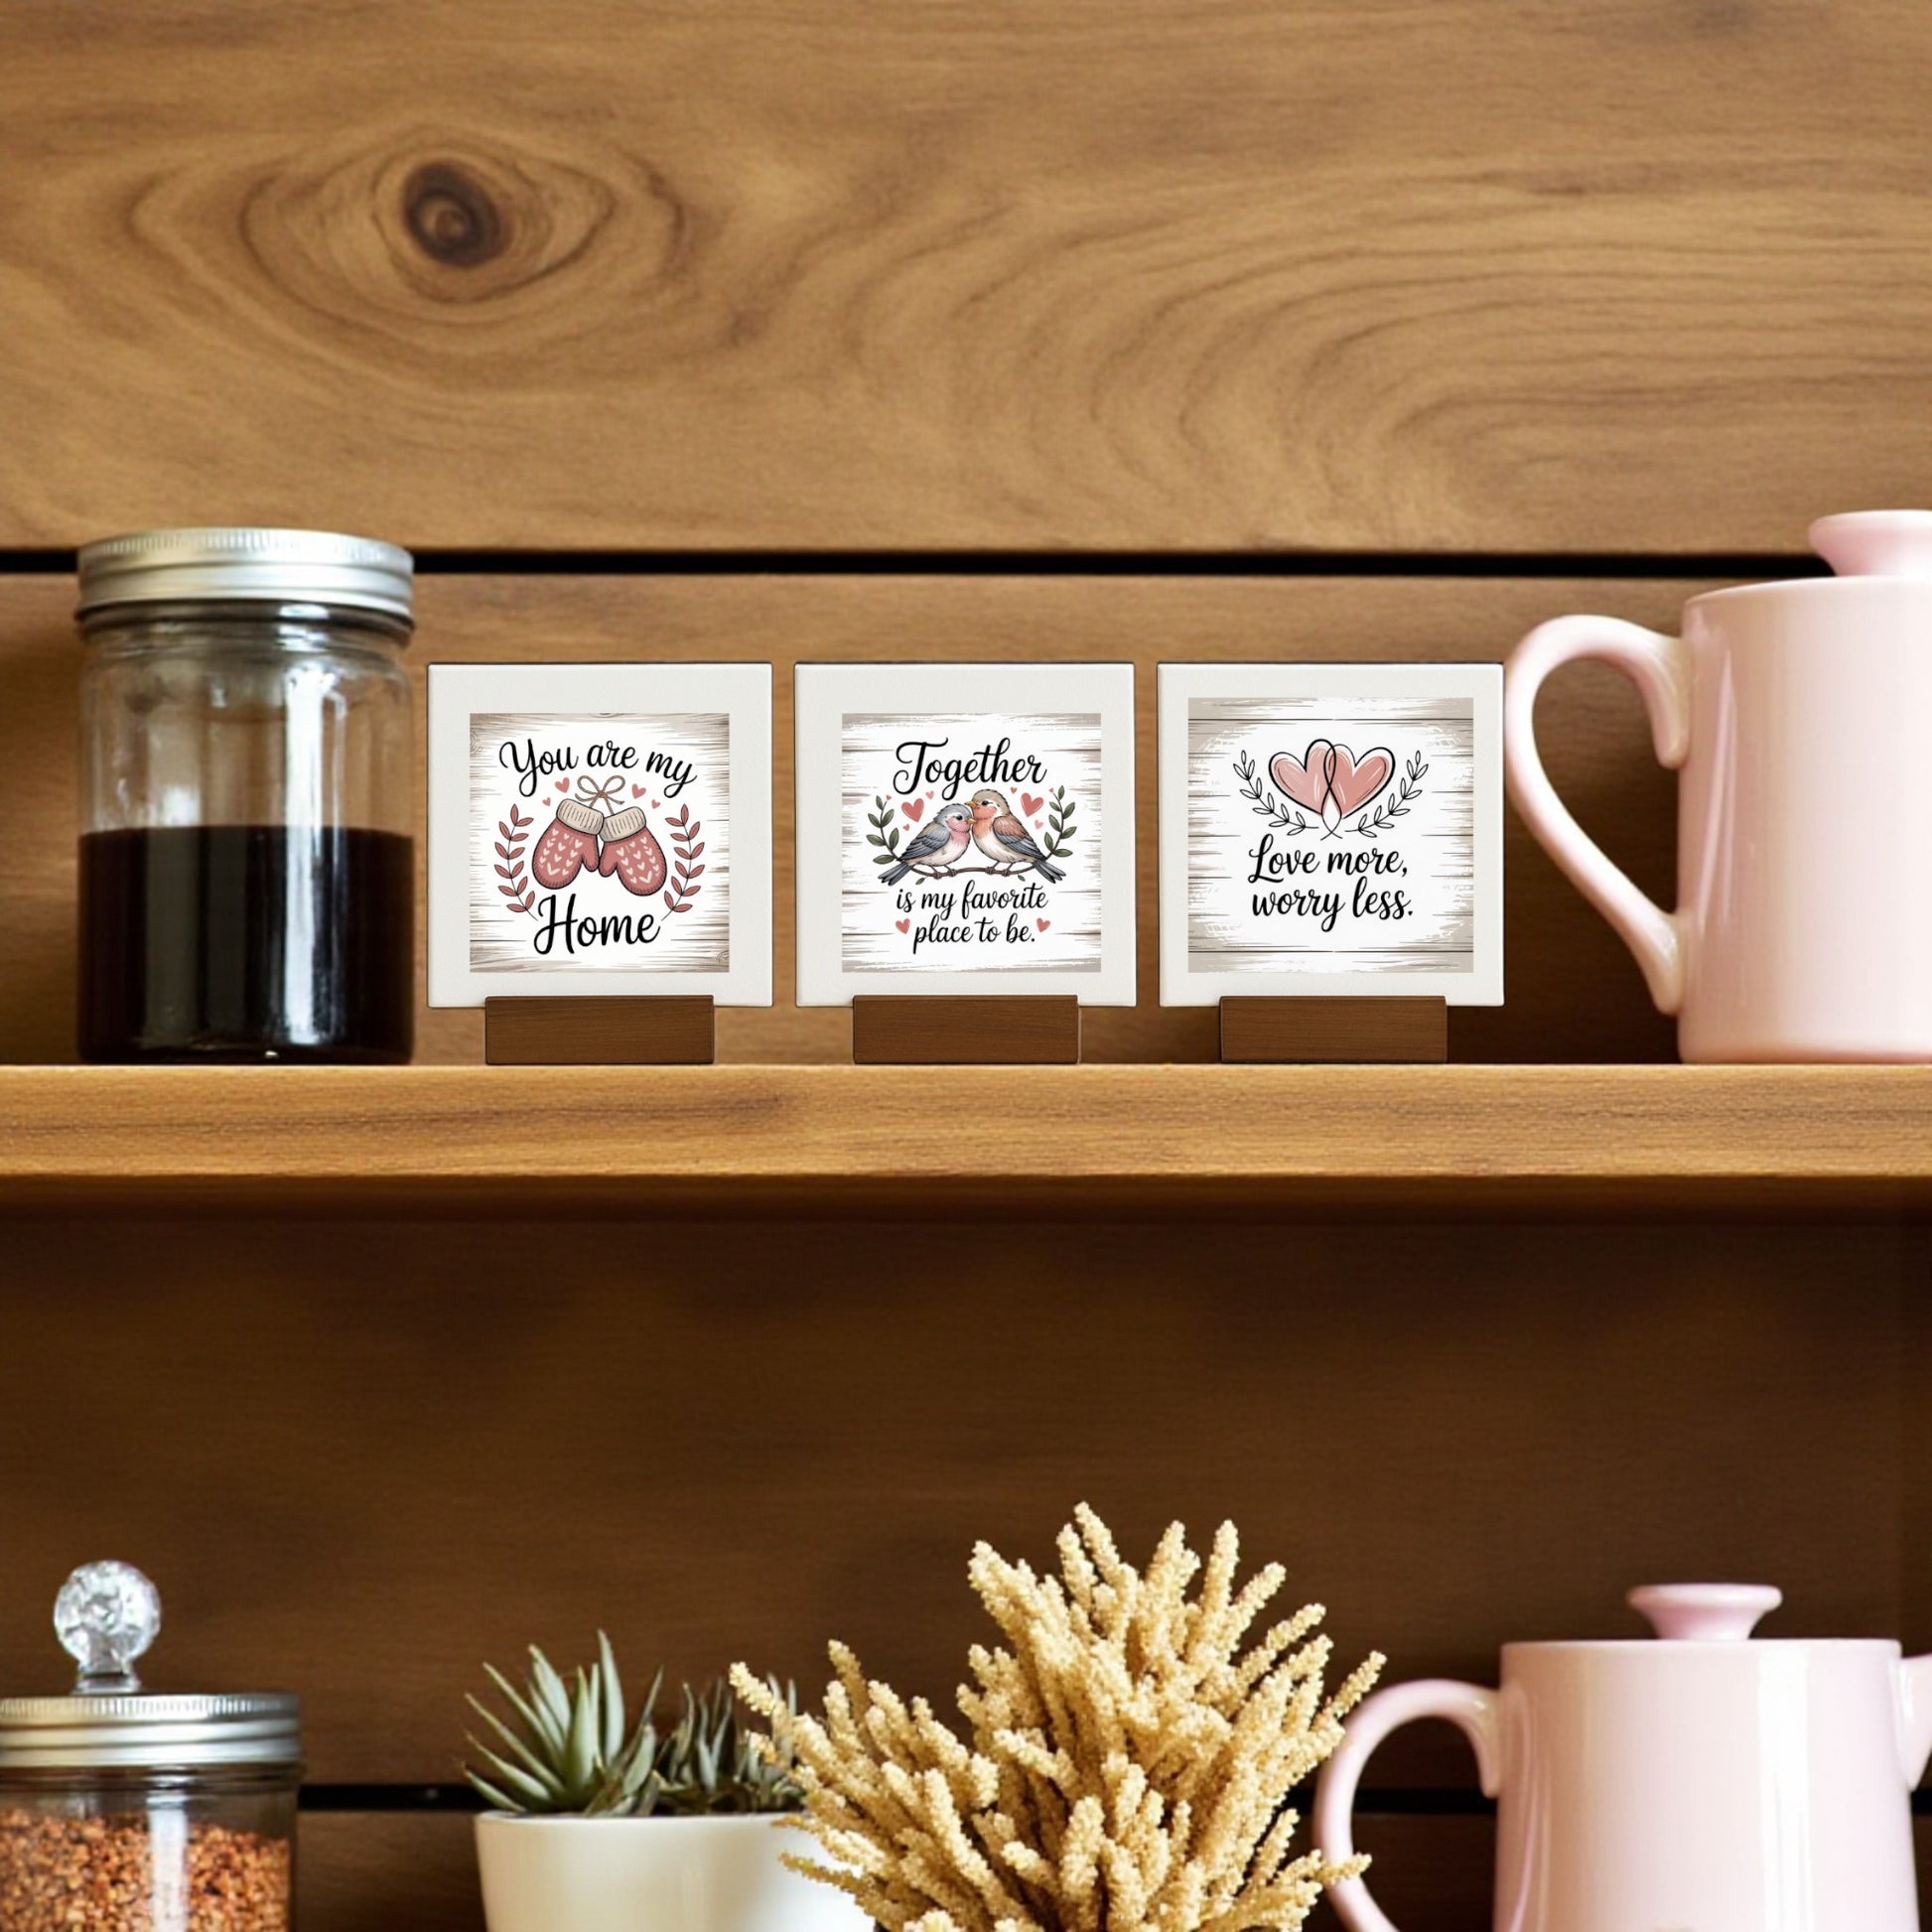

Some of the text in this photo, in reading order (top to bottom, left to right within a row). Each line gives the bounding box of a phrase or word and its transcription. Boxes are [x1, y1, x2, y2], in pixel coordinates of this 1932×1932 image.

[499, 739, 697, 798] You are my
[894, 738, 1047, 801] Together
[1248, 834, 1408, 884] Love more,
[534, 894, 661, 955] Home
[897, 880, 1048, 920] is my favorite
[1252, 876, 1413, 932] worry less.
[913, 912, 1035, 954] place to be.
